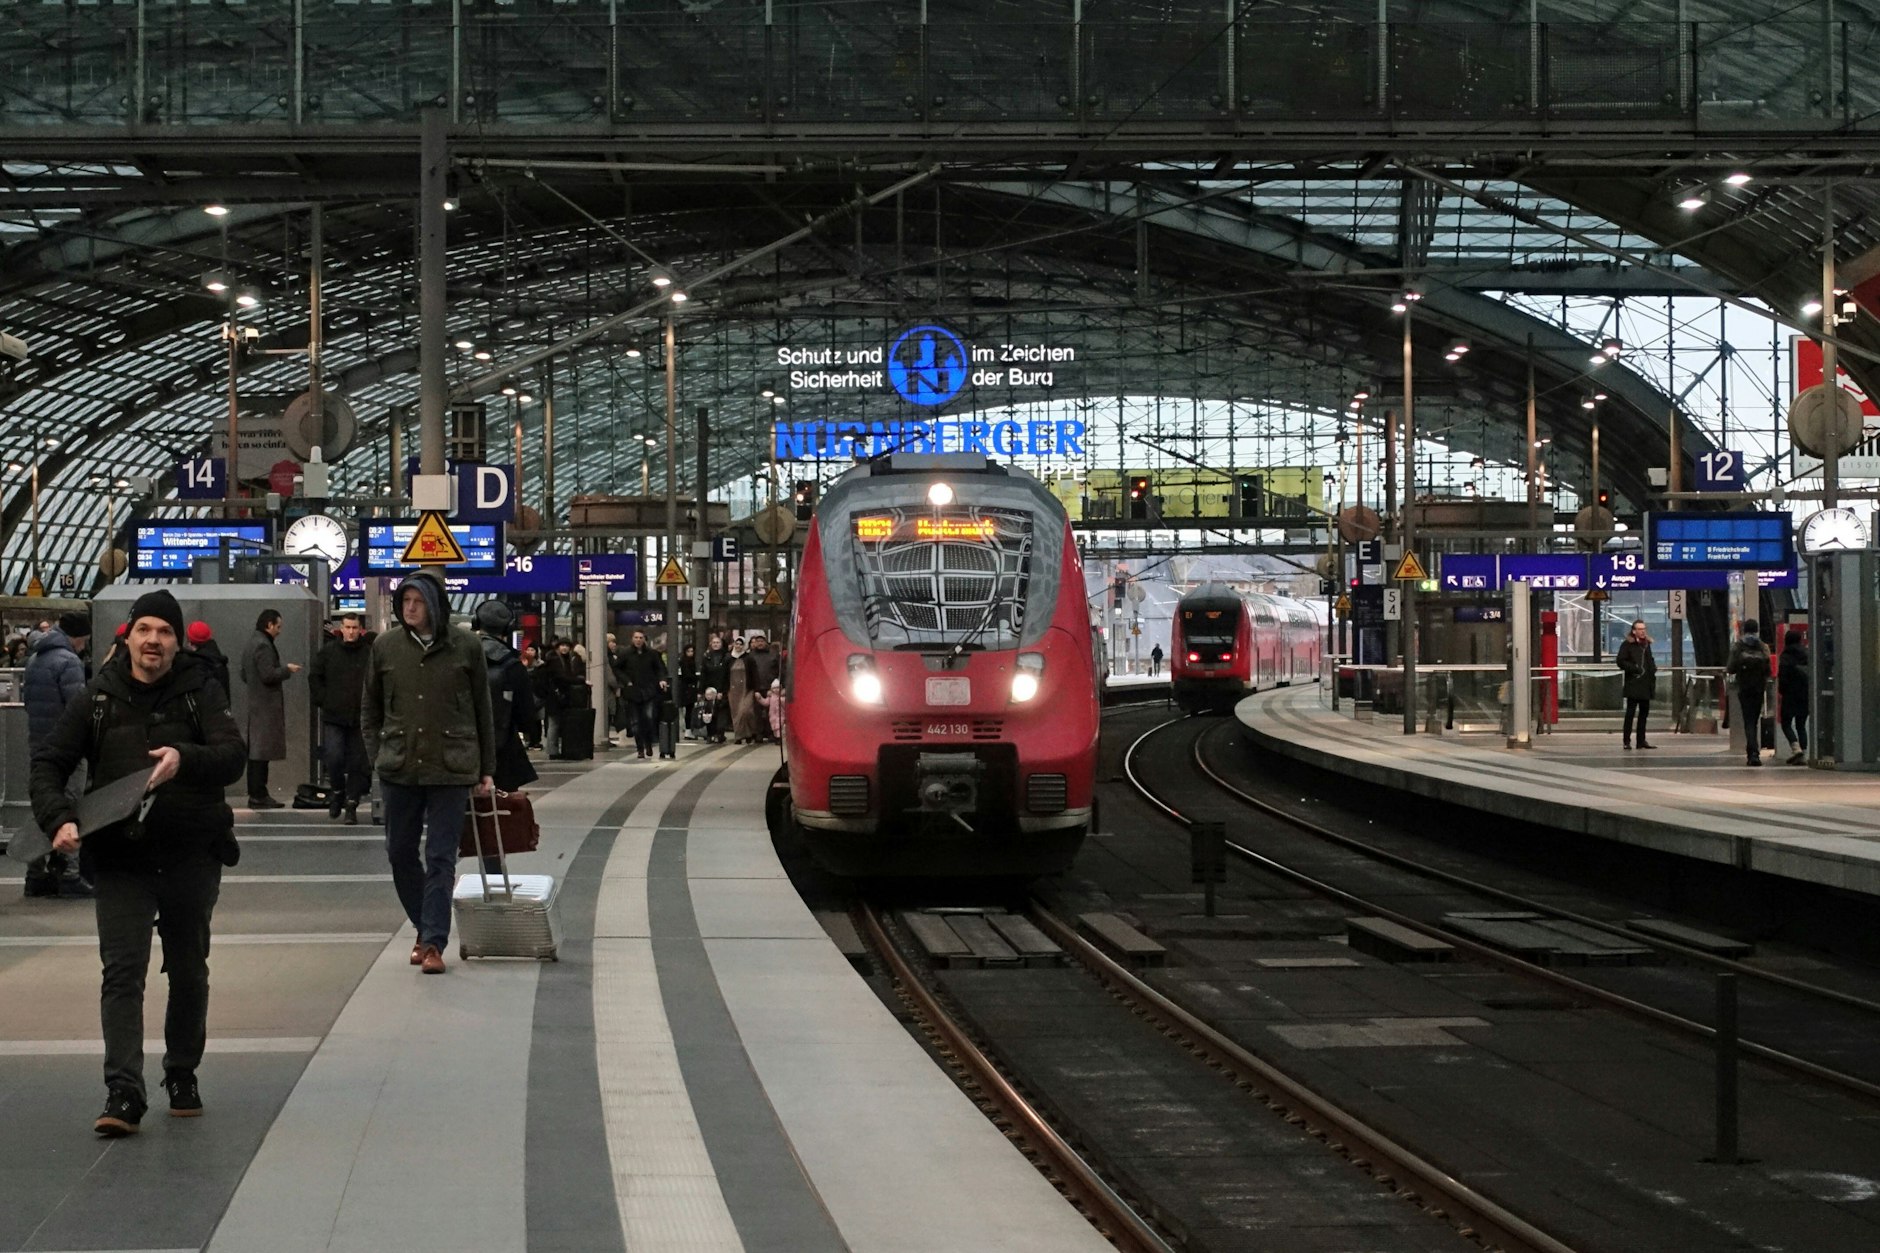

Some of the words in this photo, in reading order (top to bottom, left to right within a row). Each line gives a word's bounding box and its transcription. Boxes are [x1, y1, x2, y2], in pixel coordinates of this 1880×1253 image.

[777, 348, 842, 365] Schutz
[847, 347, 882, 363] und
[972, 344, 994, 362] im
[1000, 344, 1075, 362] Zeichen
[790, 371, 882, 388] Sicherheit
[972, 368, 1004, 386] der
[1008, 368, 1053, 387] Burg
[774, 418, 1085, 457] NÜRNBERGER
[182, 459, 215, 489] 14
[1700, 451, 1734, 481] 12
[477, 466, 508, 509] D
[163, 537, 209, 547] Wittenberge
[722, 537, 736, 557] E
[1359, 541, 1372, 560] E
[505, 556, 533, 573] -16
[1610, 554, 1637, 570] 1-8
[60, 574, 74, 586] 16
[1611, 575, 1636, 583] Ausgang
[697, 589, 705, 601] 5
[1388, 591, 1396, 602] 5
[1674, 590, 1682, 601] 5
[697, 603, 705, 614] 4
[1388, 604, 1396, 615] 4
[1489, 611, 1501, 619] 3/4
[1674, 603, 1682, 614] 4
[927, 724, 947, 735] 442
[949, 724, 969, 735] 130
